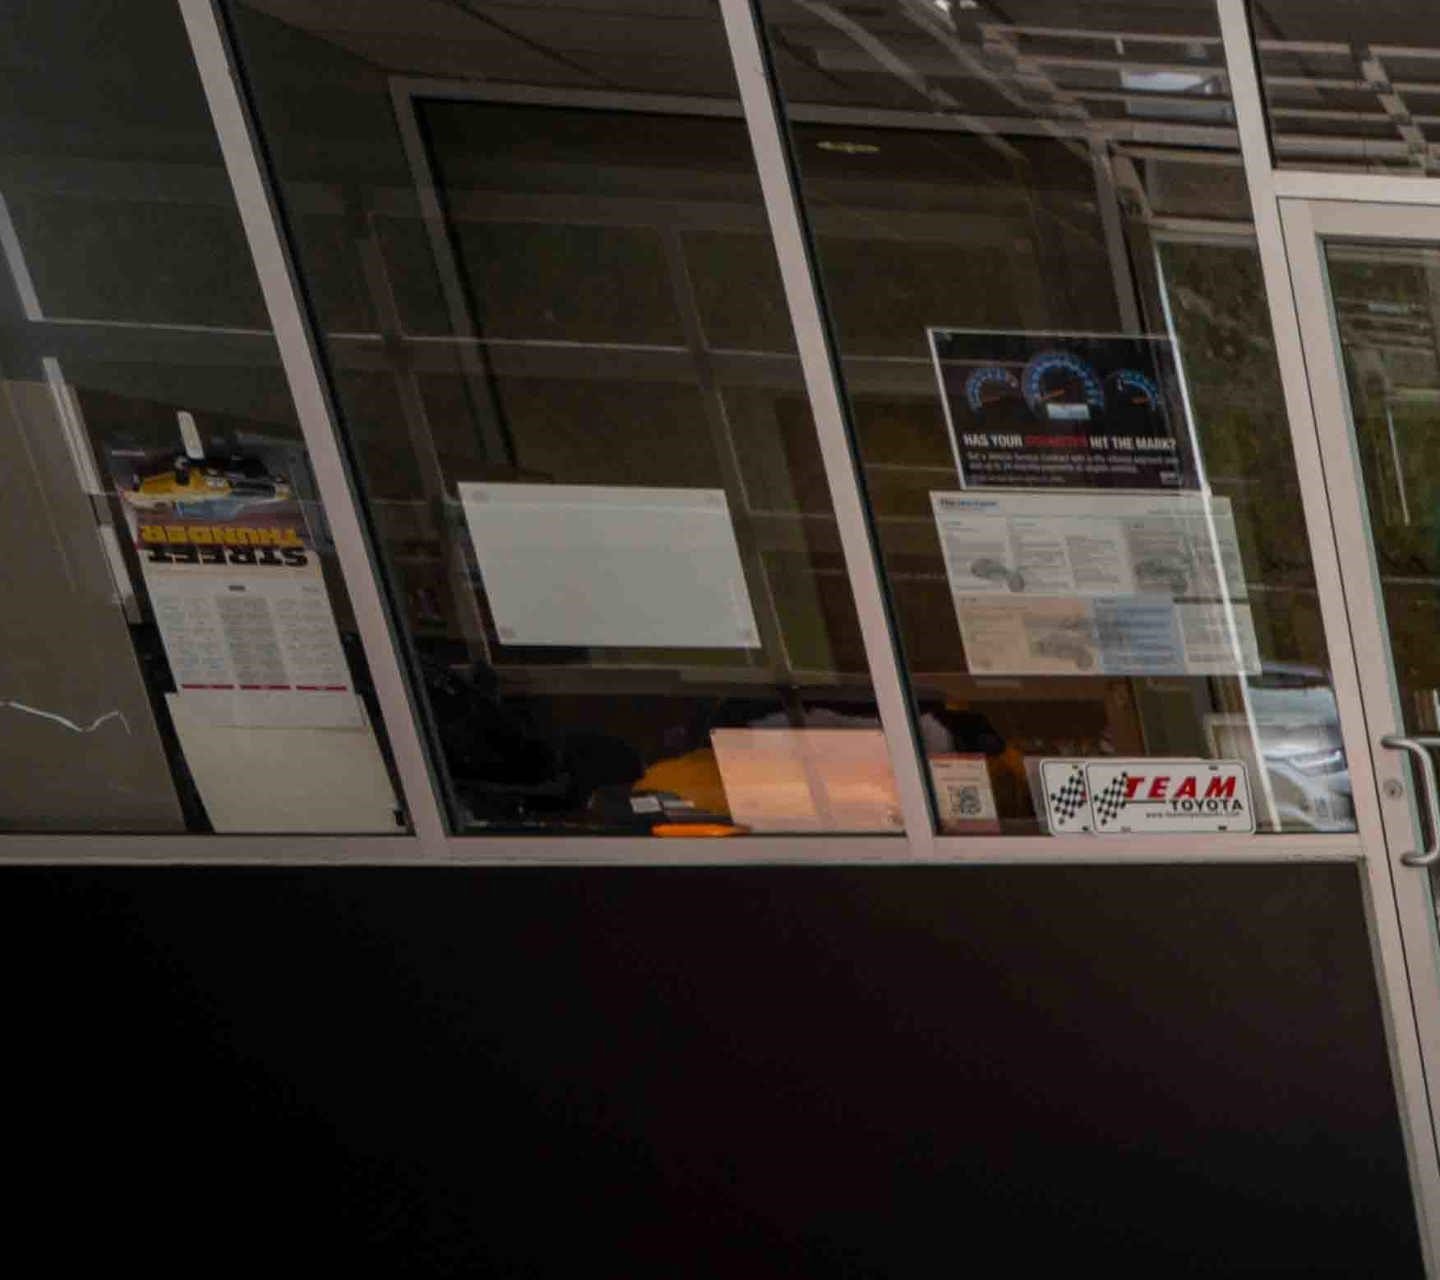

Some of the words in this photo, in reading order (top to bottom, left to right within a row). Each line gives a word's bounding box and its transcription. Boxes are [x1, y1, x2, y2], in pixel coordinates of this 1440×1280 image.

[963, 433, 988, 447] HAS
[991, 434, 1023, 448] YOUR
[1090, 437, 1109, 449] HIT
[1112, 437, 1134, 449] THE
[1136, 437, 1177, 450] MARK?
[140, 525, 304, 548] THUNDER
[148, 545, 308, 566] STREET
[1122, 775, 1238, 799] TEAM
[1170, 799, 1244, 812] TOYOTA
